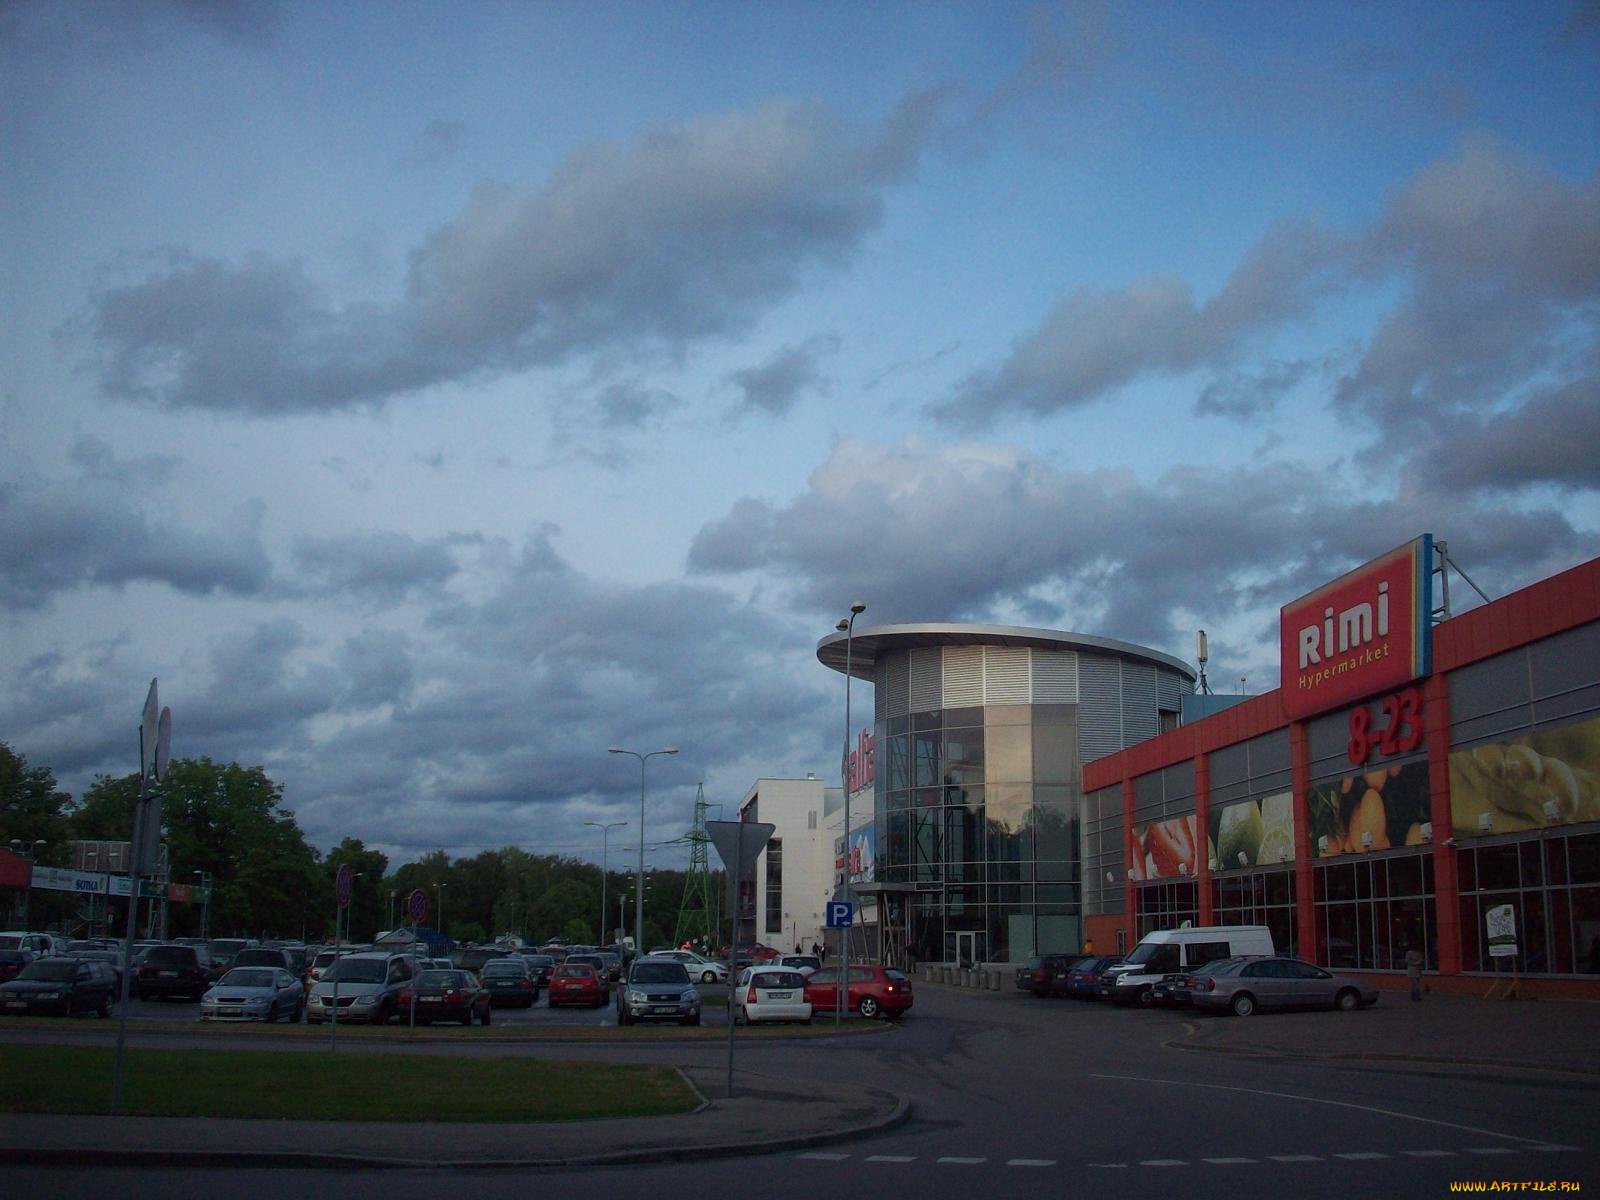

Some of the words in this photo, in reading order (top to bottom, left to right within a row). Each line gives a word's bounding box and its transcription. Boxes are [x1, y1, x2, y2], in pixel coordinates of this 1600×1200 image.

[1299, 580, 1389, 670] Rimi
[1299, 642, 1390, 690] Hypermarket
[1348, 686, 1425, 766] 8-23
[832, 904, 849, 926] P
